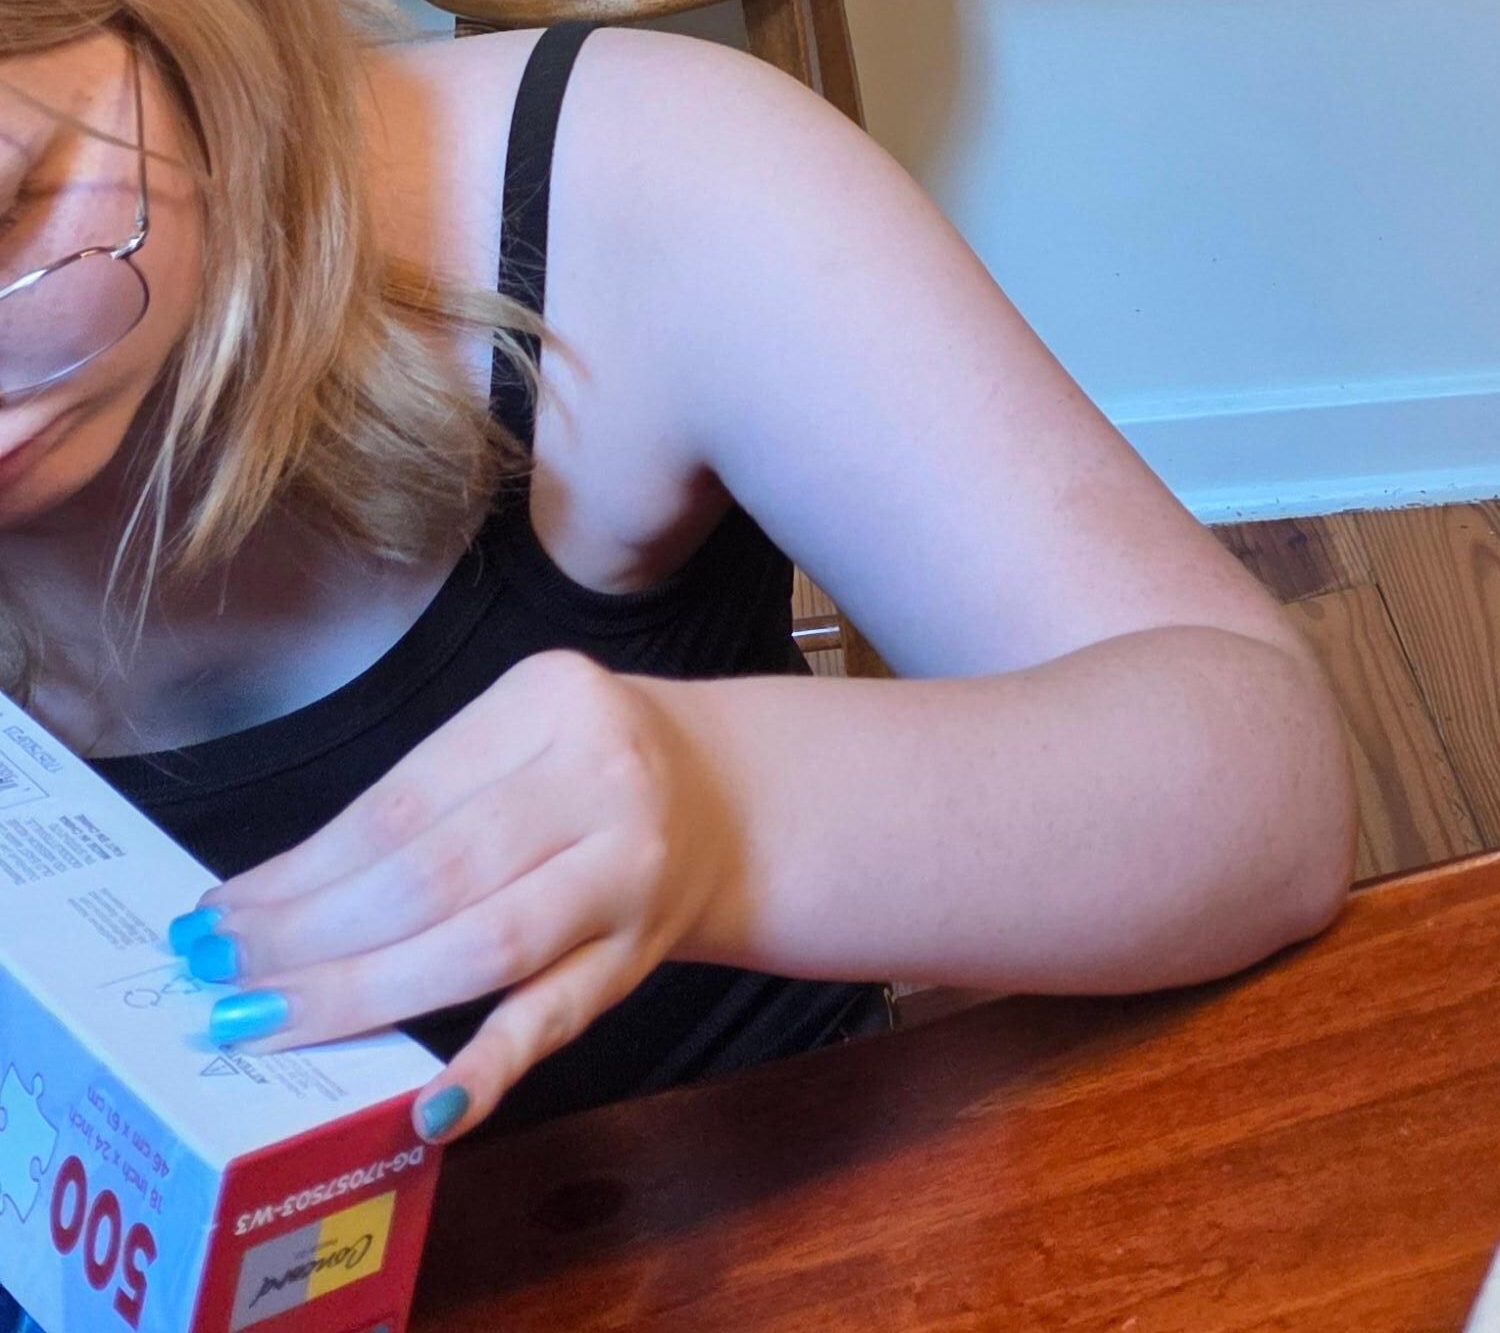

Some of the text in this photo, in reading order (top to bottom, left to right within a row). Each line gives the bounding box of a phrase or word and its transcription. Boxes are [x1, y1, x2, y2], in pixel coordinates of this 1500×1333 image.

[87, 1085, 109, 1114] cm
[68, 1104, 96, 1143] inch
[94, 1133, 111, 1161] 24
[131, 1131, 152, 1157] cm
[152, 1151, 171, 1177] 46
[120, 1162, 149, 1202] inch
[149, 1192, 165, 1214] 18
[50, 1155, 159, 1331] 500
